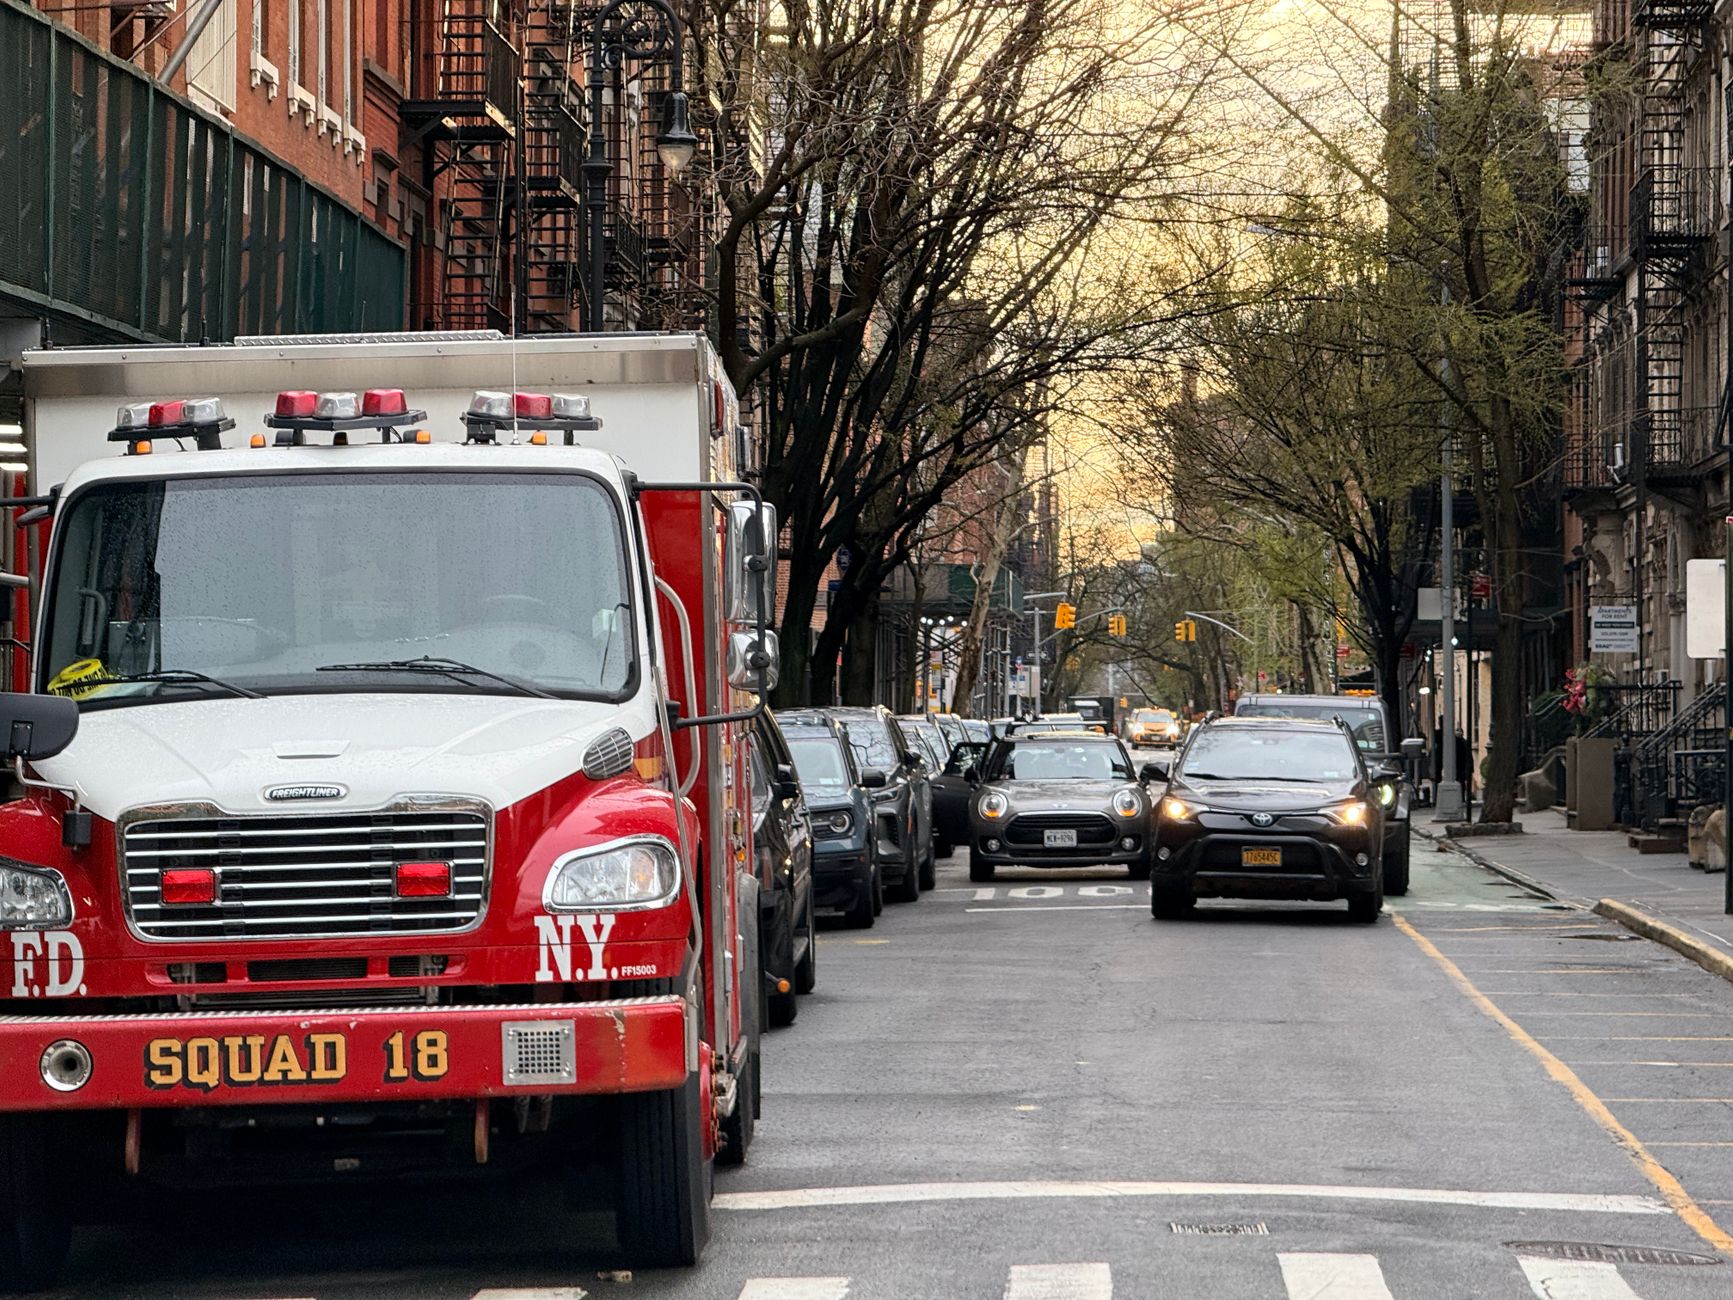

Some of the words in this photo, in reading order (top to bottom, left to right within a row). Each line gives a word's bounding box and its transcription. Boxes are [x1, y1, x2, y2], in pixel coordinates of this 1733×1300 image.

[271, 787, 339, 799] FREIGHTLINER
[10, 930, 87, 997] F.D.
[533, 914, 619, 982] N.Y.
[621, 965, 657, 976] FF15003
[145, 1033, 347, 1091] SQUAD
[384, 1030, 449, 1083] 18
